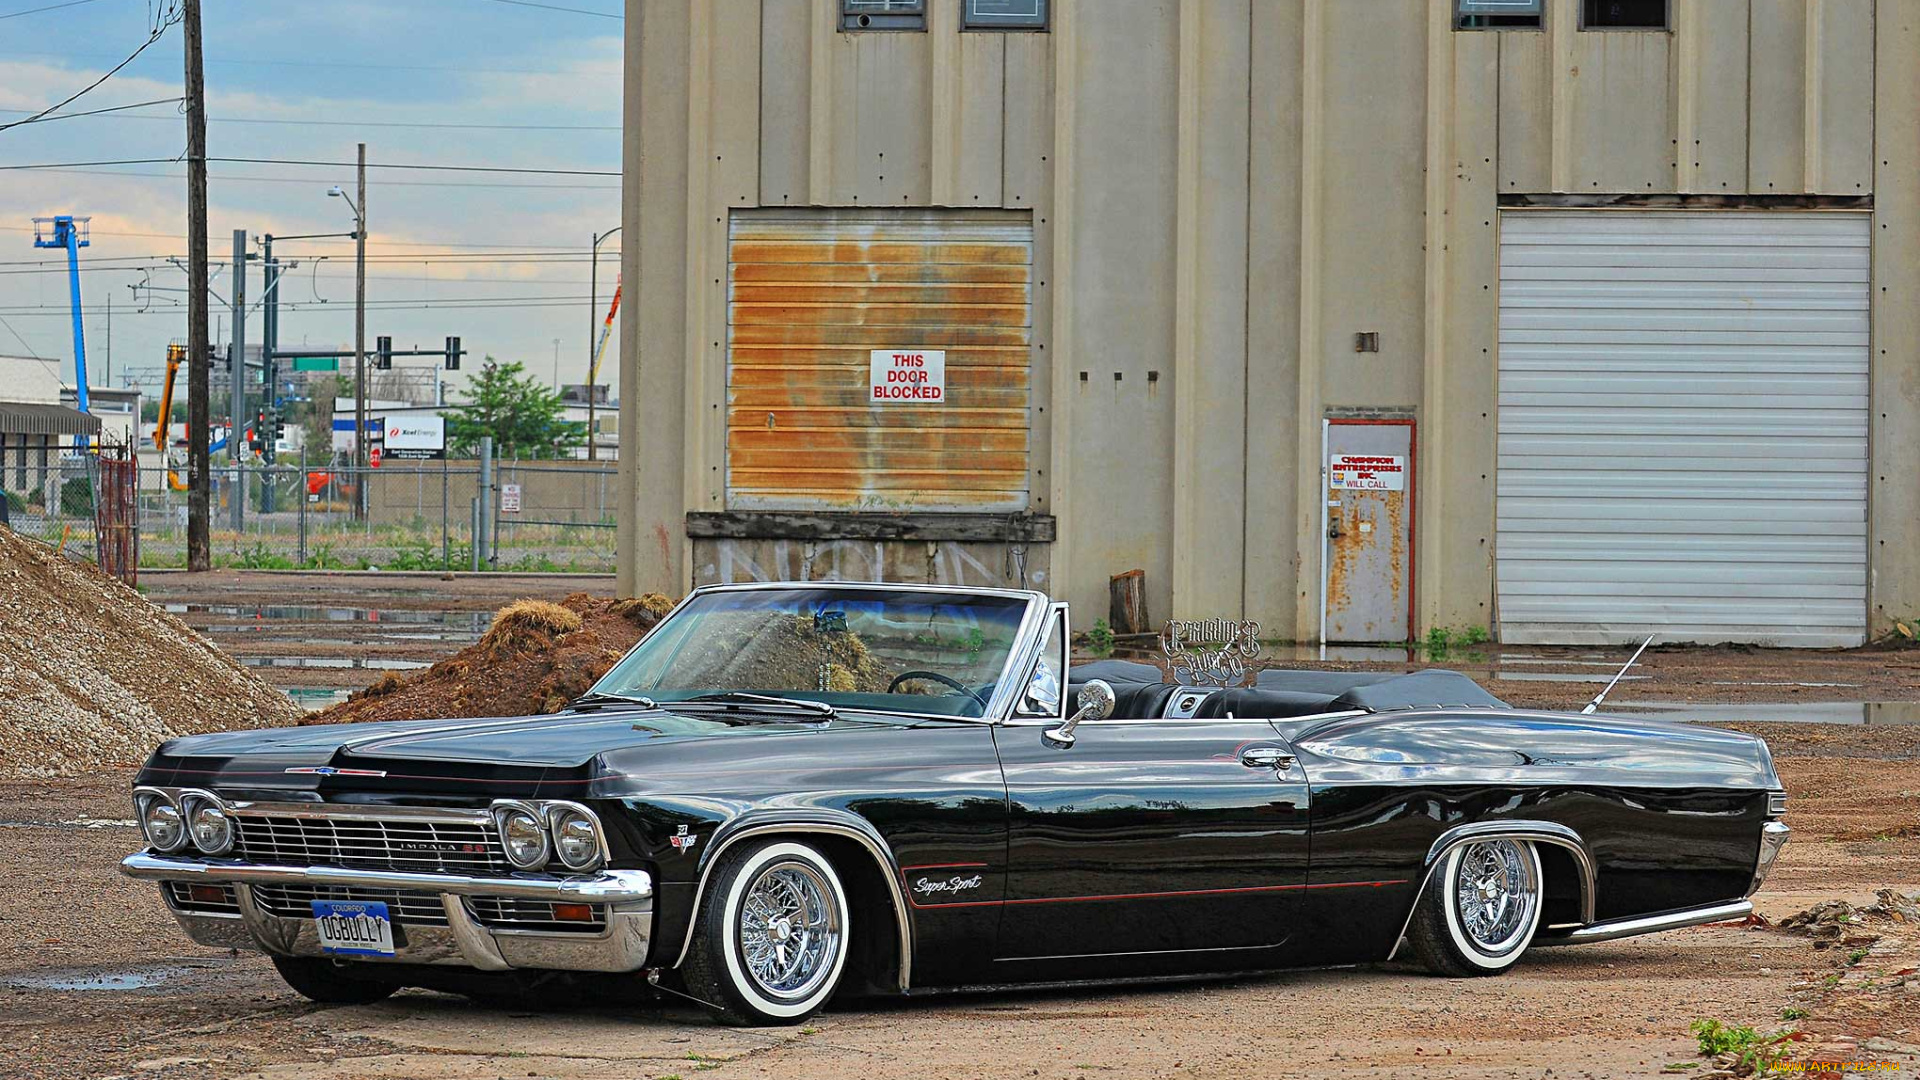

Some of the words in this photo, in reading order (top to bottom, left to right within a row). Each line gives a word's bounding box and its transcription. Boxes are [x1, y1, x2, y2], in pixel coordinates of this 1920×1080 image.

[892, 354, 924, 367] THIS
[887, 370, 928, 383] DOOR
[873, 386, 941, 399] BLOCKED
[1332, 464, 1402, 472] ENTERPRISES
[1346, 480, 1365, 488] WILL
[1367, 481, 1388, 489] CALL
[400, 843, 457, 851] IMPALA
[913, 877, 950, 897] Super
[947, 874, 982, 895] Sport
[331, 904, 367, 913] COLORADO
[321, 916, 383, 943] OGBULLY
